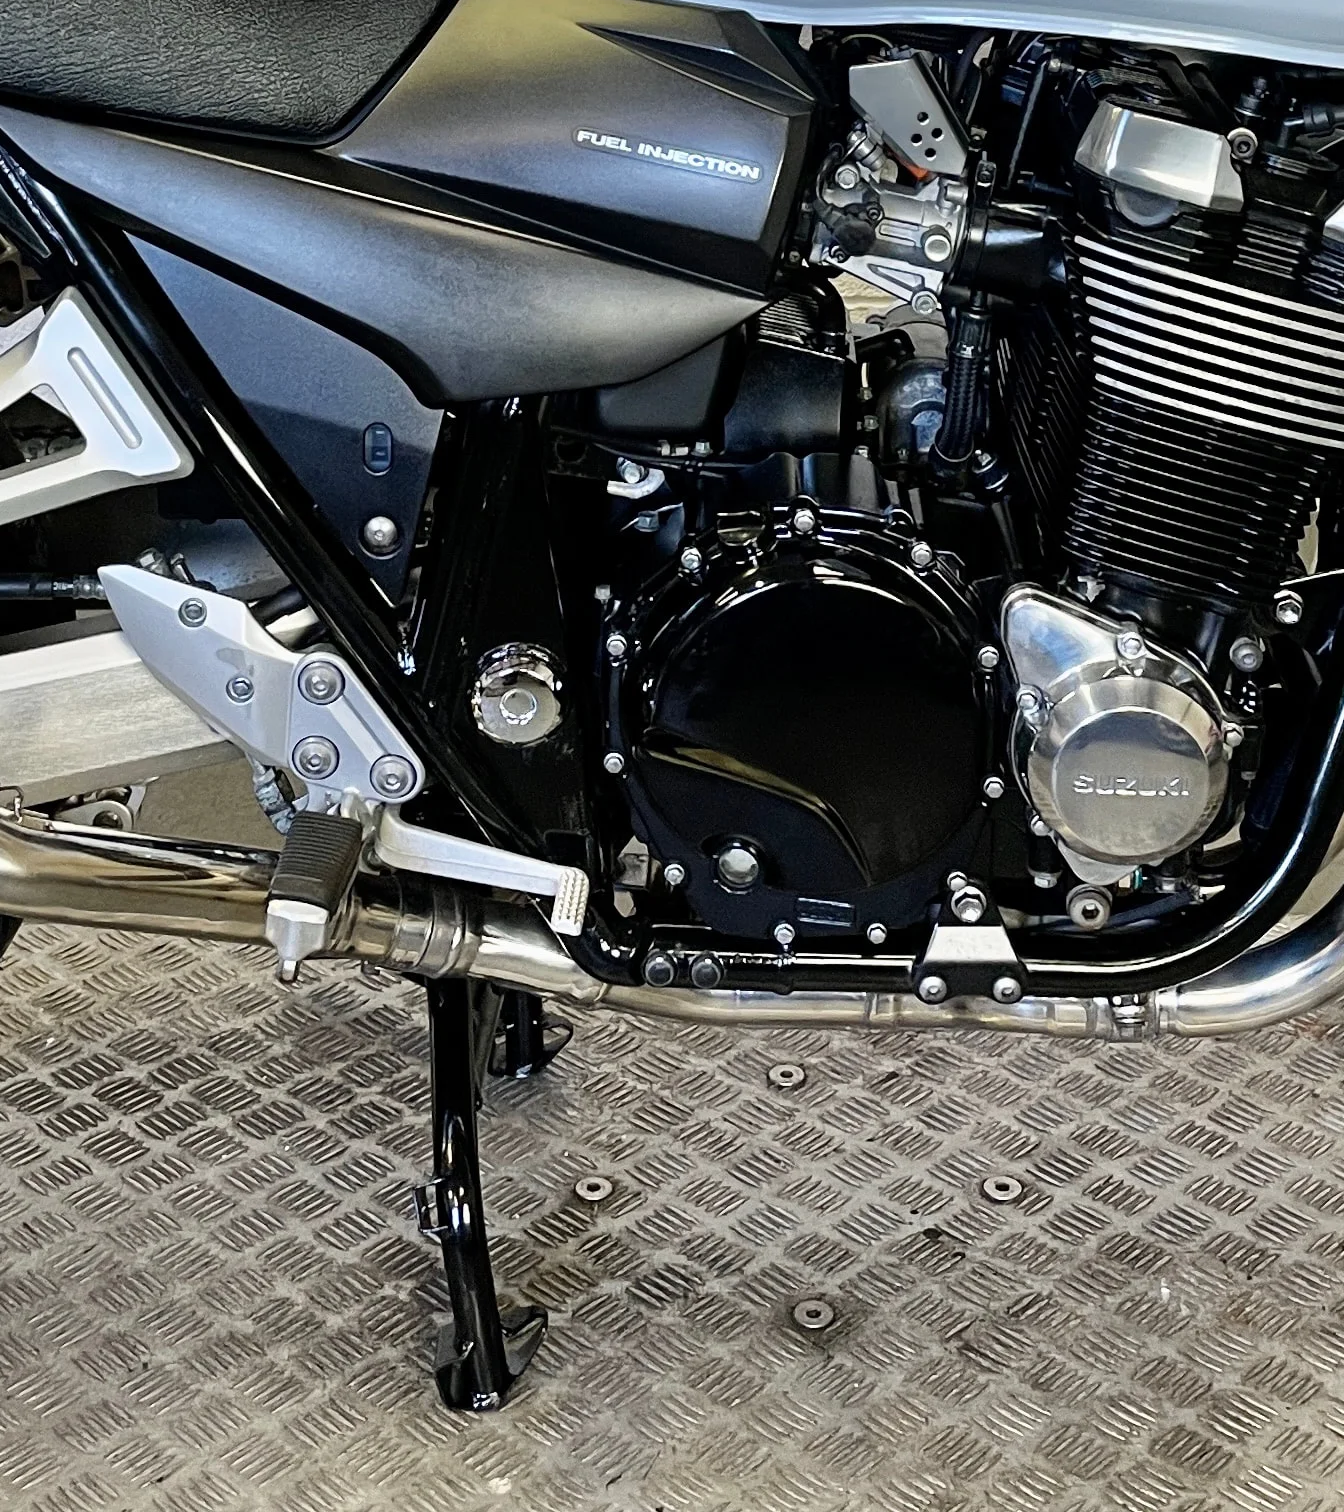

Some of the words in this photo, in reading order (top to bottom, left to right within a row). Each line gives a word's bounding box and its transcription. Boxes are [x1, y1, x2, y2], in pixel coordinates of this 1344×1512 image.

[577, 130, 632, 152] FUEL
[637, 142, 760, 180] INJECTION
[1072, 774, 1190, 797] SUZUKI
